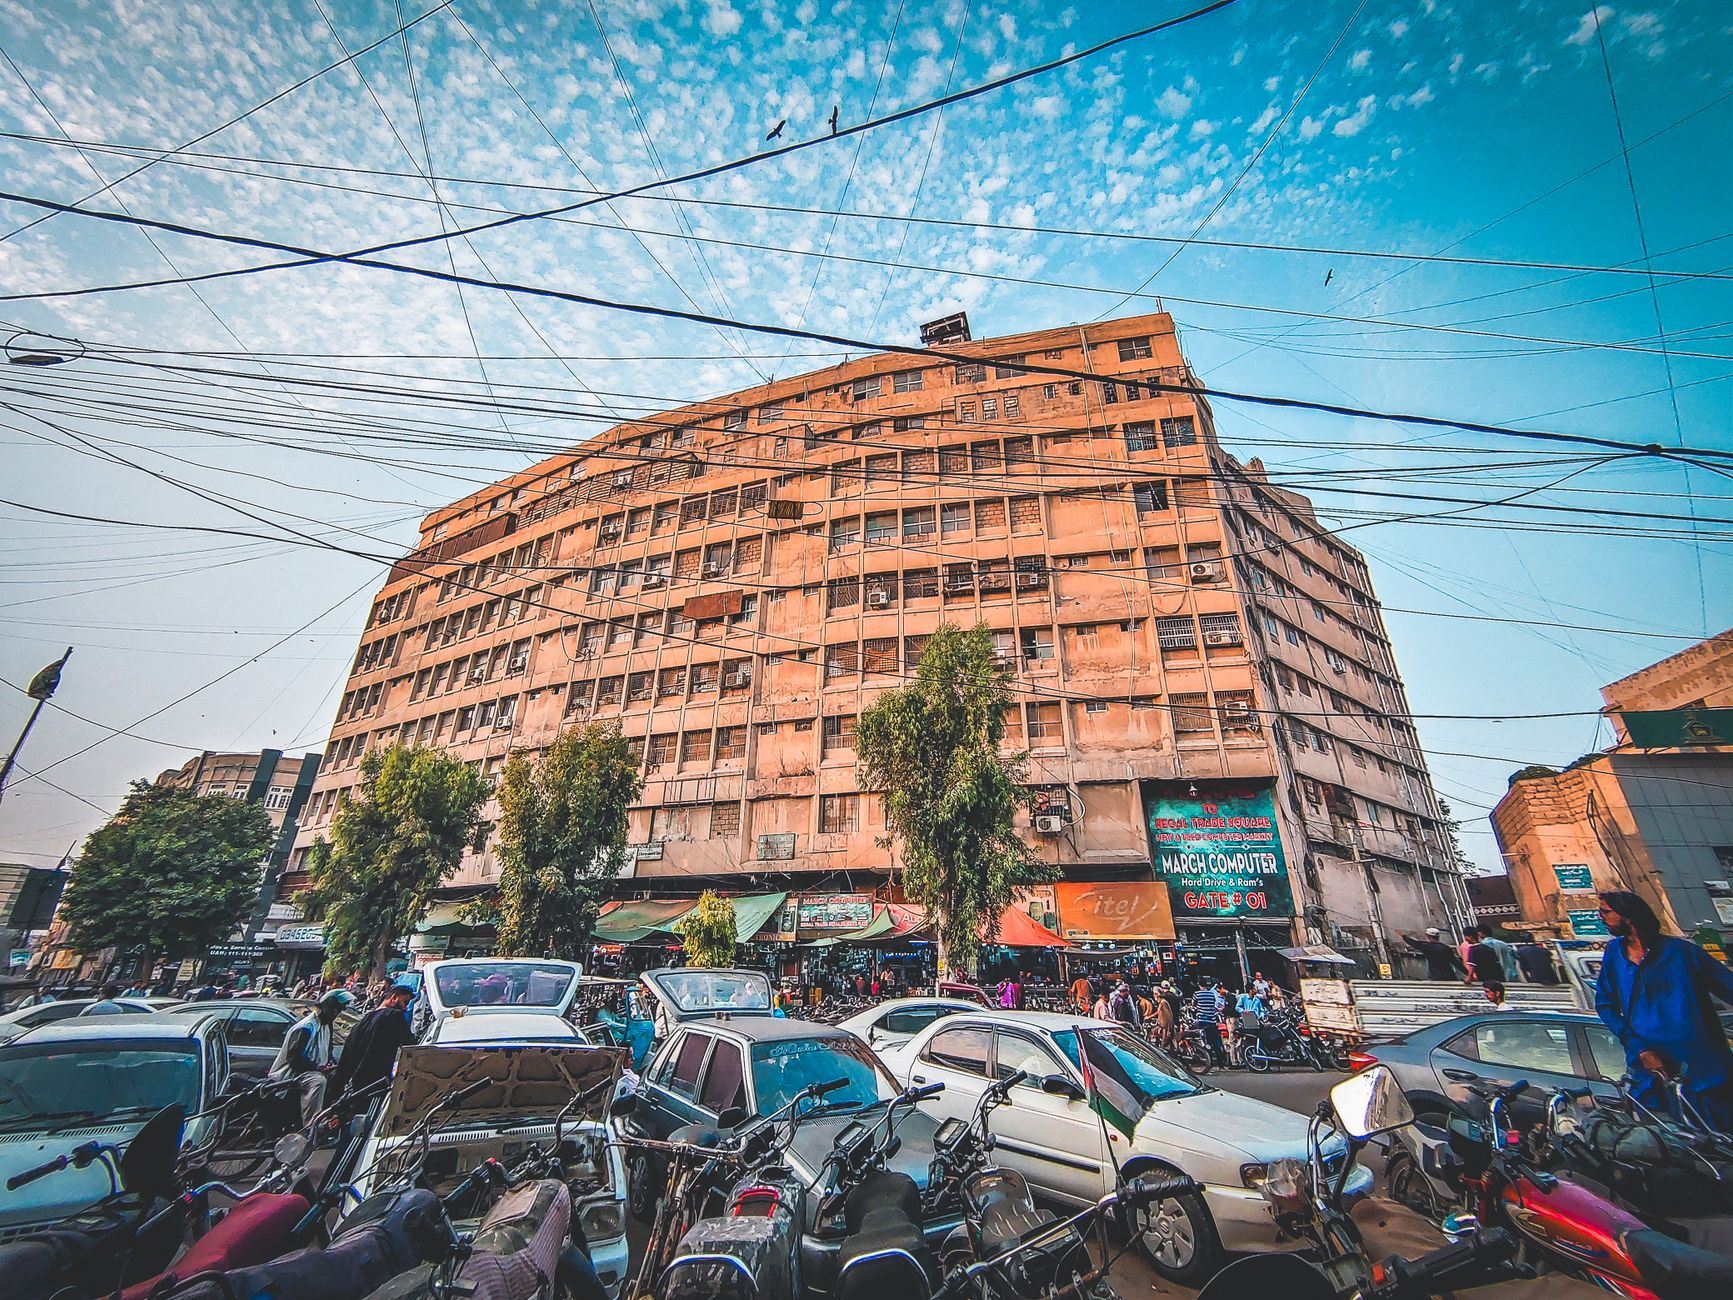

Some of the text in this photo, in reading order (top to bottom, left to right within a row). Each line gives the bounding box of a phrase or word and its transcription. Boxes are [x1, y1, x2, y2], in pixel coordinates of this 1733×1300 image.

[1201, 803, 1217, 815] TO
[1154, 816, 1272, 829] REGAL TRADE SQUARE
[1202, 832, 1241, 842] COMPUTER
[1161, 853, 1278, 874] MARCH COMPUTER
[1181, 877, 1263, 887] Hard Drive & Ram's
[1094, 895, 1140, 915] itel
[1184, 891, 1267, 909] GATE # 01
